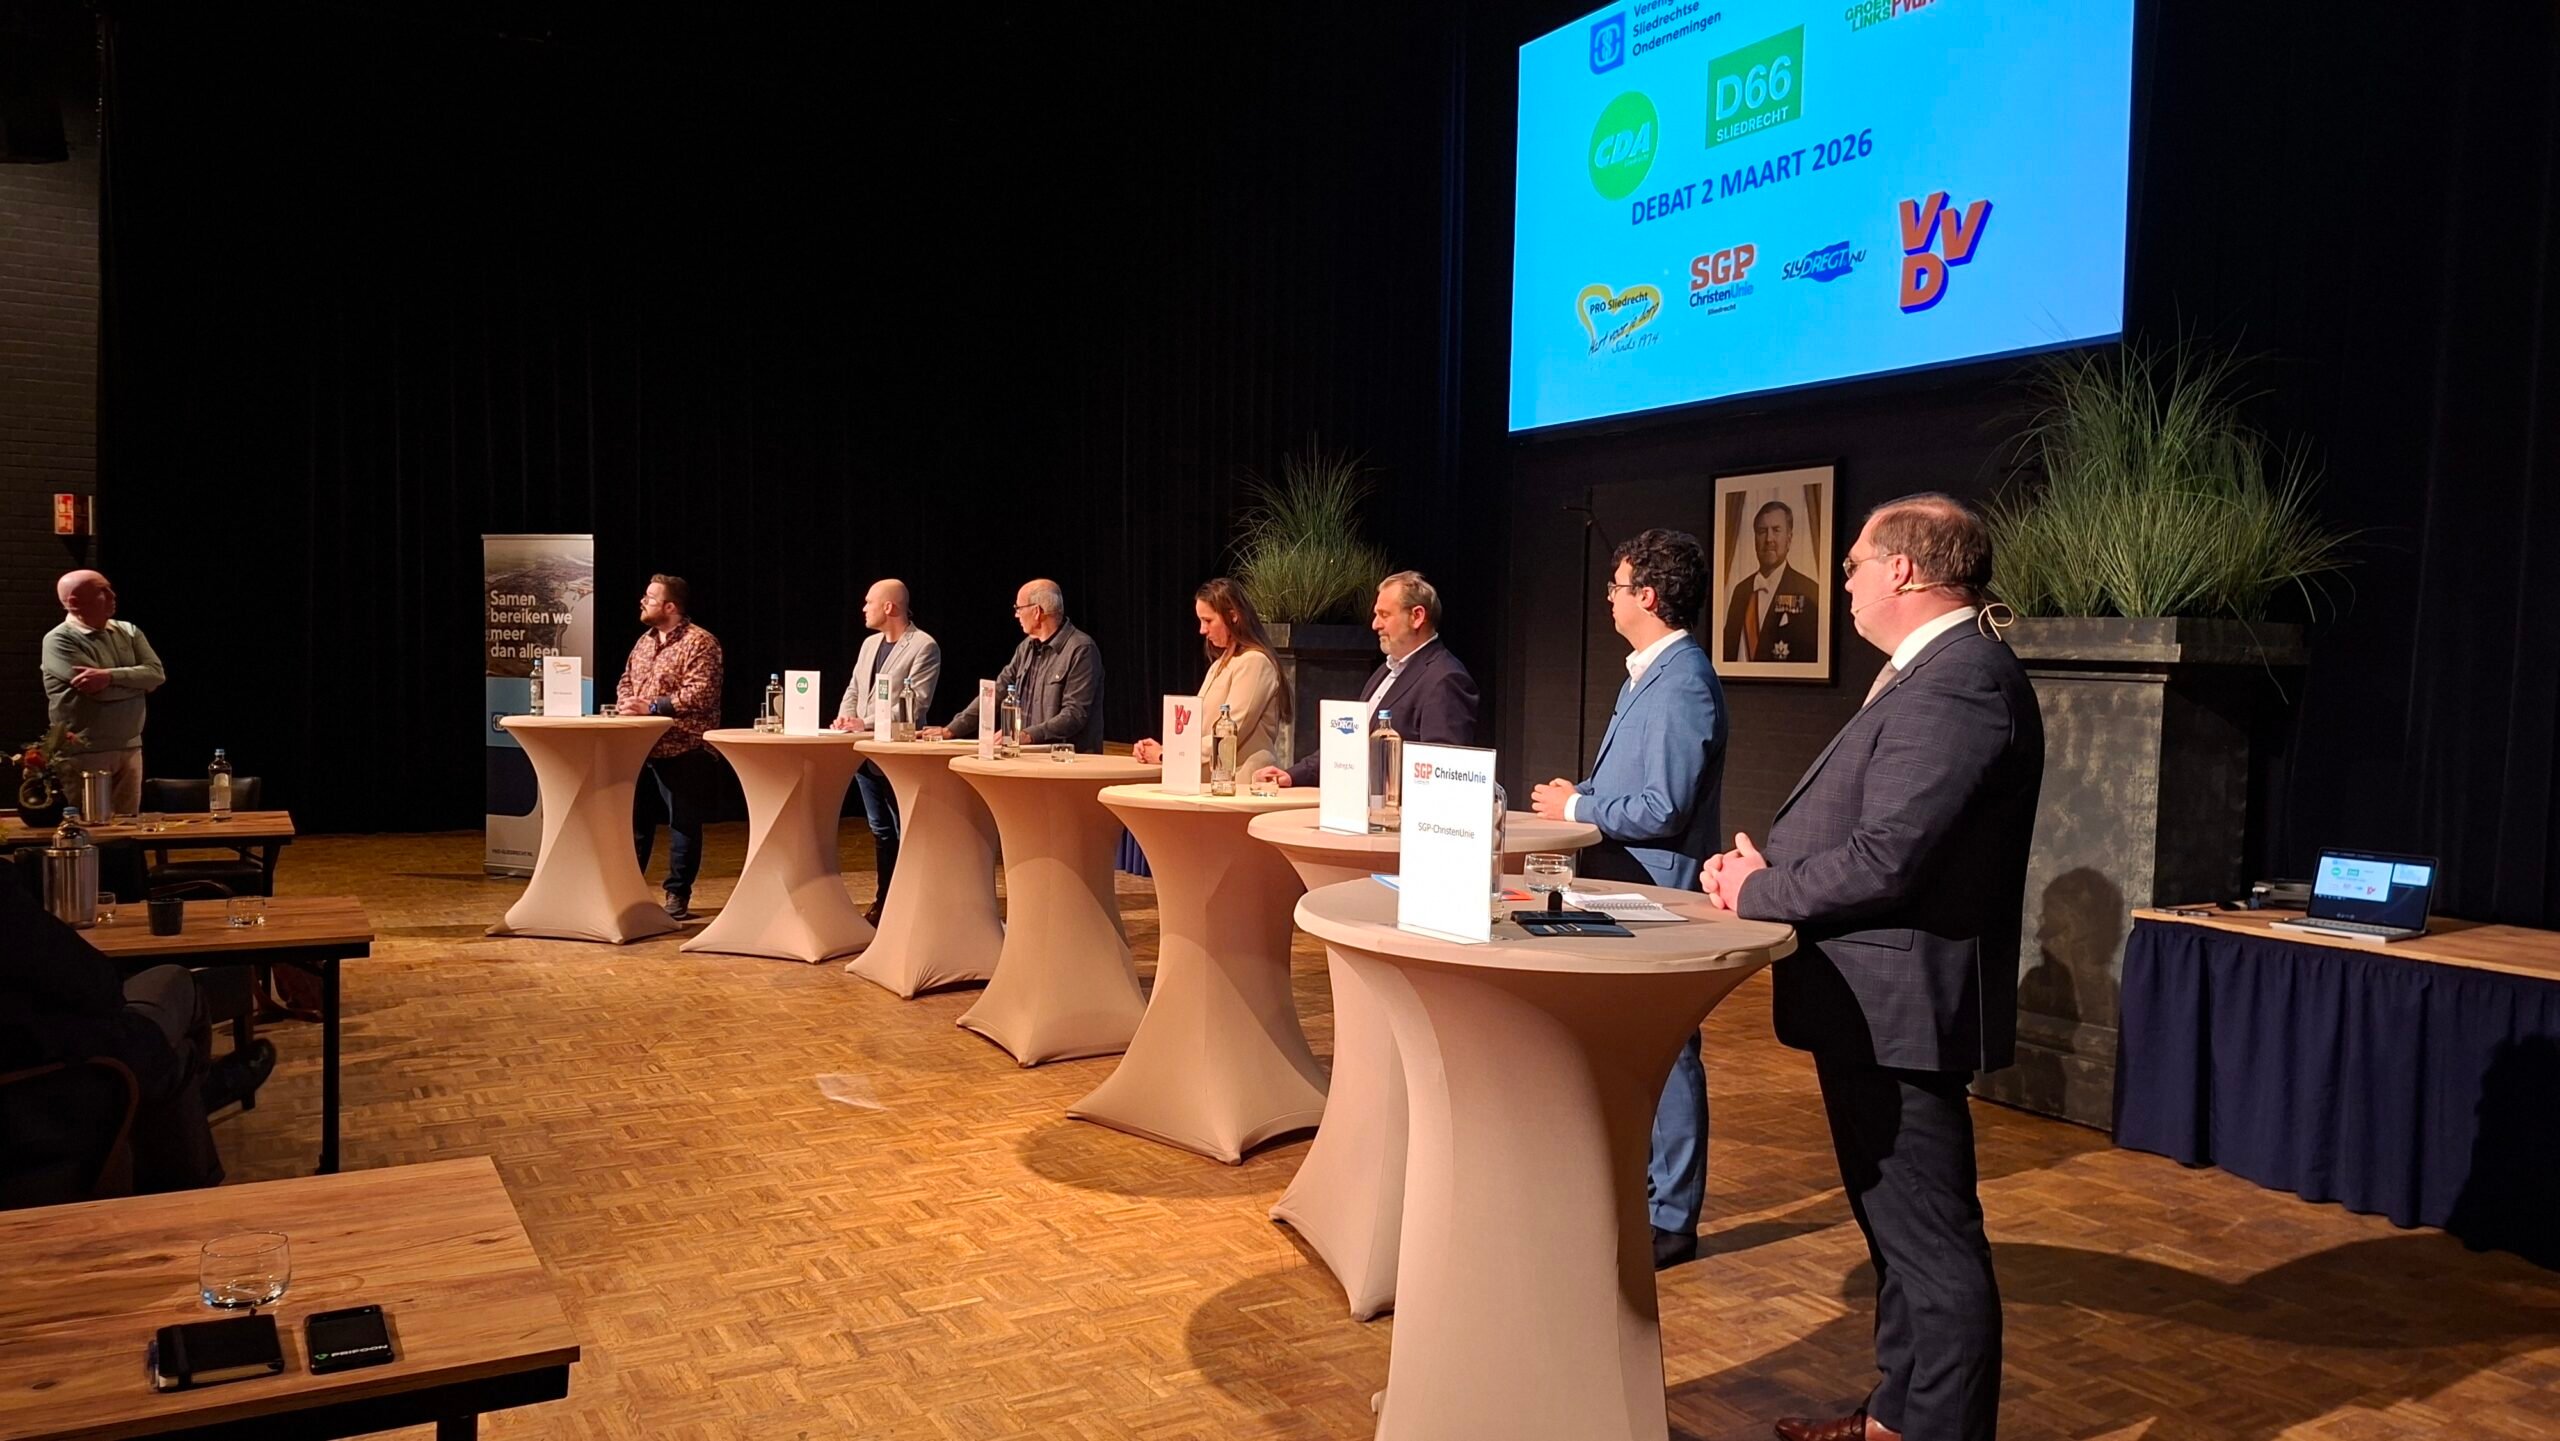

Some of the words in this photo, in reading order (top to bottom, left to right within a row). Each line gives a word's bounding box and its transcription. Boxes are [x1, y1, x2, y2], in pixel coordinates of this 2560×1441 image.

[1633, 1, 1700, 37] Sliedrechtse
[1852, 7, 1891, 32] LINKS
[1632, 12, 1721, 56] Ondernemingen
[1715, 55, 1792, 121] D66
[1716, 106, 1789, 142] SLIEDRECHT
[1595, 121, 1650, 169] CDA
[1631, 184, 1697, 226] DEBAT
[1701, 179, 1714, 205] 2
[1720, 149, 1806, 199] MAART
[1812, 128, 1873, 171] 2026
[1690, 243, 1755, 291] SGP
[1590, 301, 1606, 315] PRO
[1607, 291, 1648, 310] Sliedrecht
[1689, 283, 1754, 308] ChristenUnie
[490, 590, 536, 606] Samen
[490, 608, 549, 624] bereiken
[553, 613, 573, 624] we
[490, 628, 526, 641] meer
[490, 642, 516, 658] dan
[519, 643, 559, 659] alleen
[1175, 704, 1192, 735] VVD
[1414, 762, 1433, 780] SGP
[1434, 767, 1487, 784] ChristenUnie
